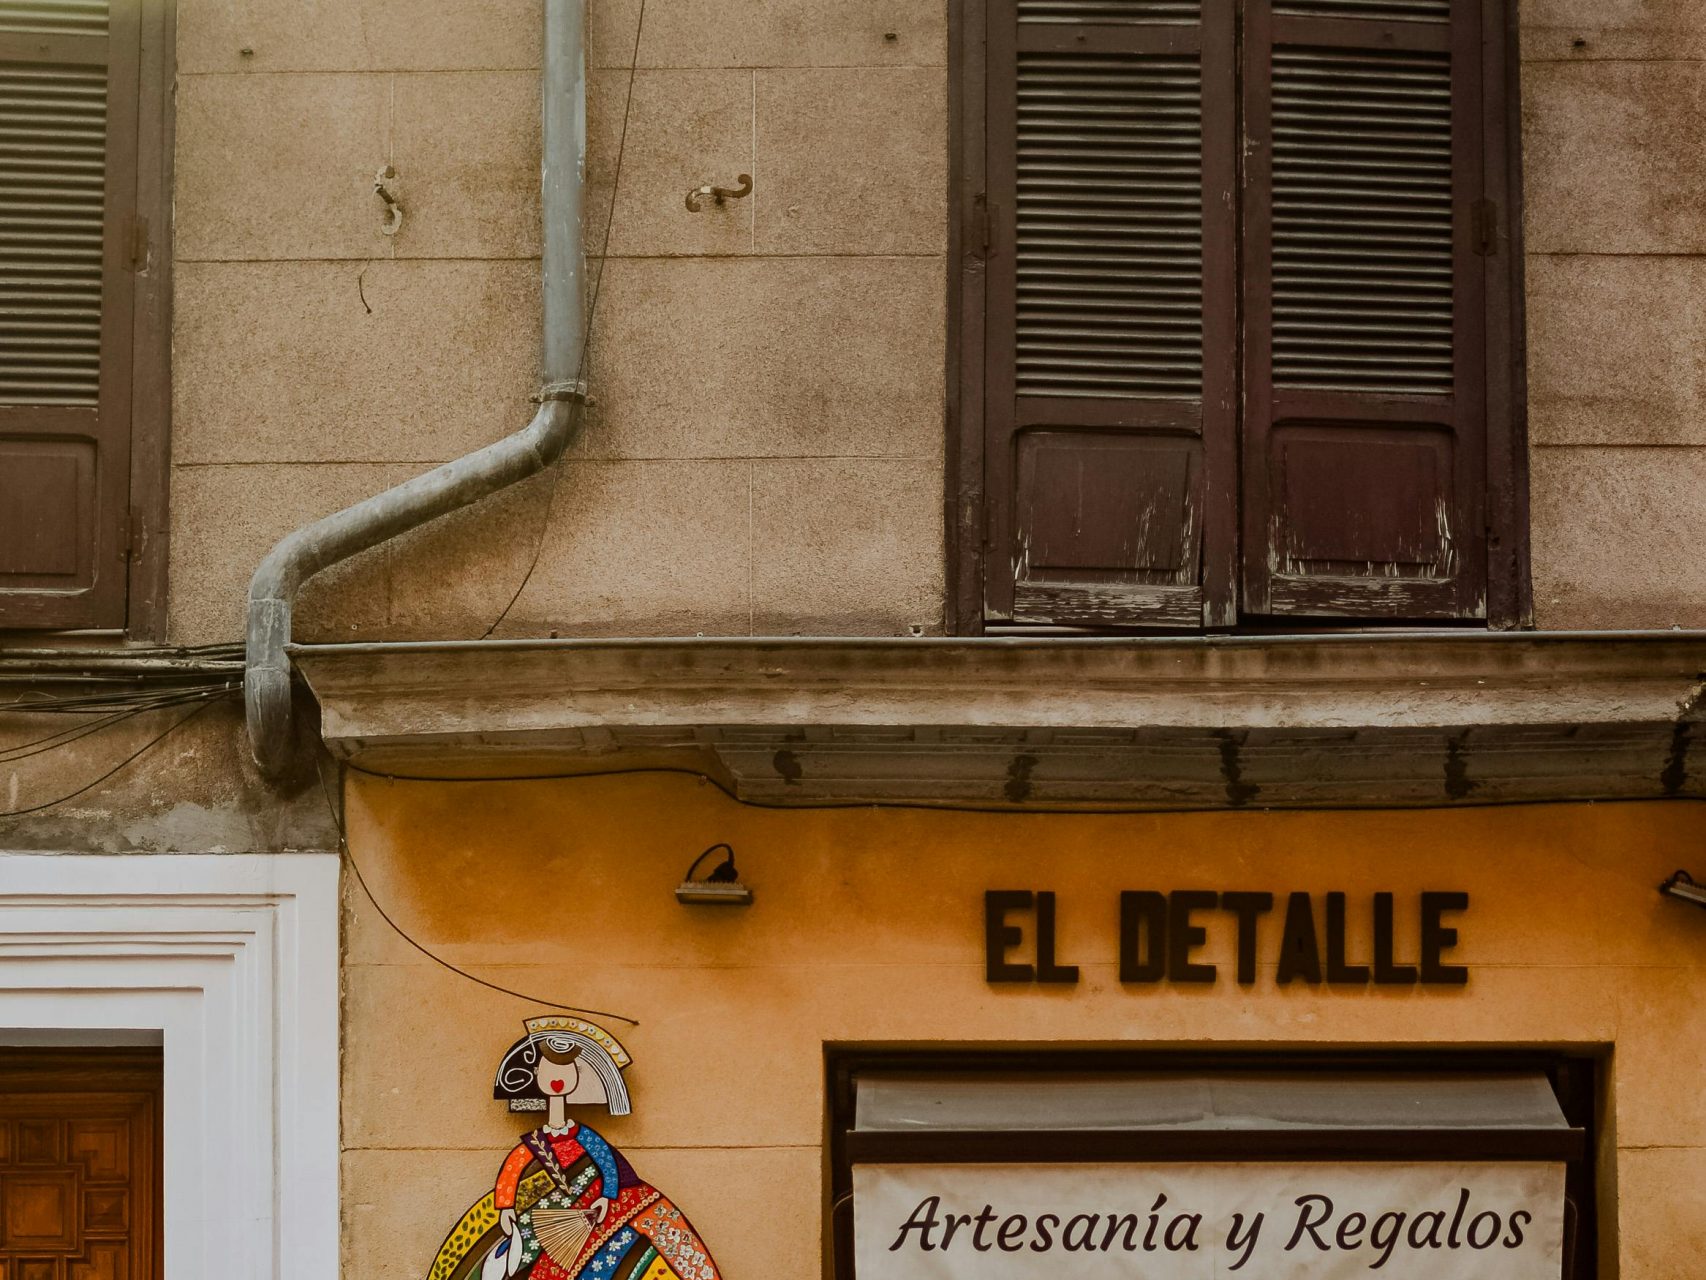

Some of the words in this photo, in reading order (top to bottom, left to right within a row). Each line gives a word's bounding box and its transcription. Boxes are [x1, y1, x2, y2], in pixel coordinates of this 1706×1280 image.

[984, 890, 1079, 984] EL
[1119, 890, 1469, 985] DETALLE
[888, 1193, 1203, 1253] Artesanía
[1225, 1211, 1266, 1271] y
[1284, 1188, 1532, 1269] Regalos
